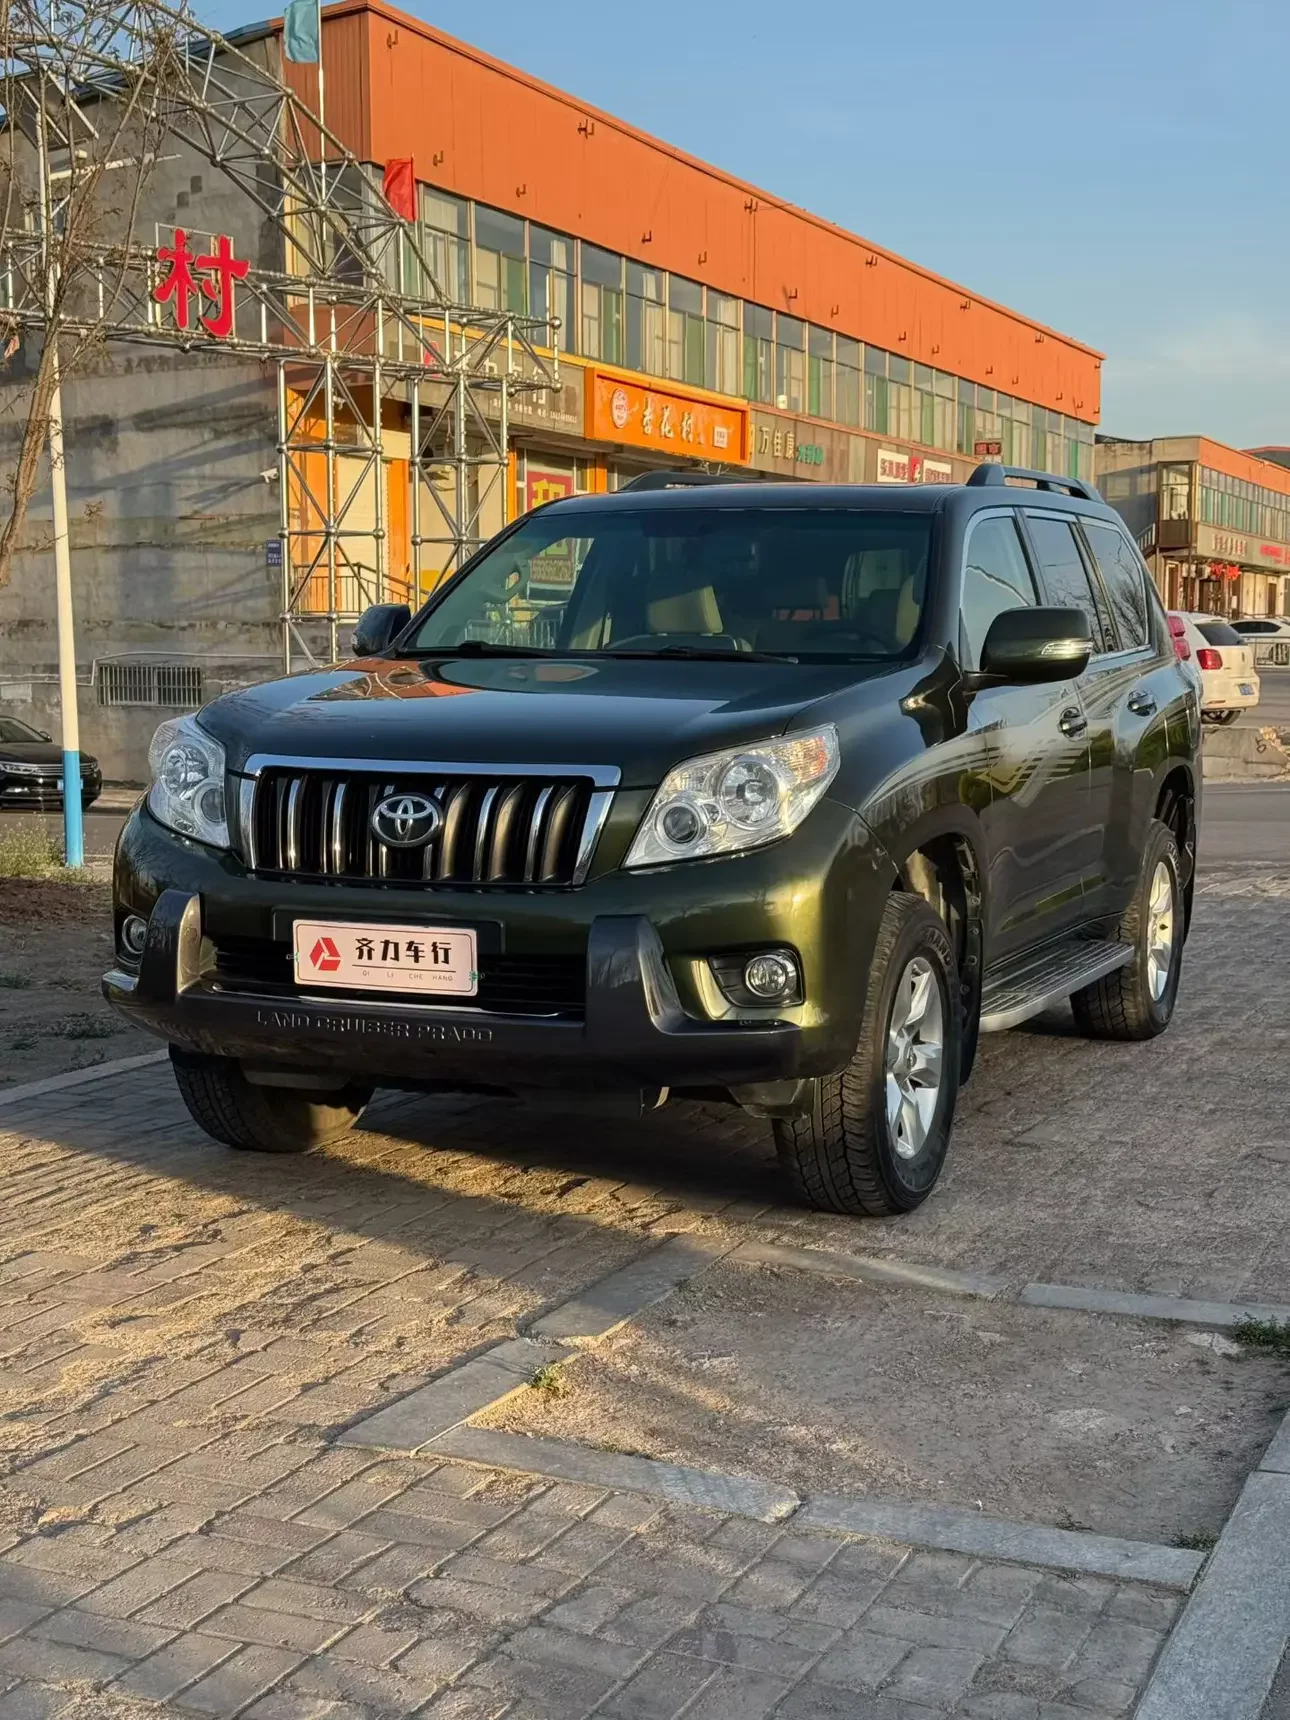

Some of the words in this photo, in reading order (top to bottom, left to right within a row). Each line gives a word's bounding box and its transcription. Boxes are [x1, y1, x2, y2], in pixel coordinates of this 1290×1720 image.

[153, 227, 251, 337] 村
[355, 938, 452, 965] 齐力车行
[362, 969, 370, 977] QI
[432, 974, 454, 982] HANG
[257, 1010, 310, 1028] LAND
[316, 1015, 409, 1038] CRUISER
[418, 1023, 493, 1042] PRADO
